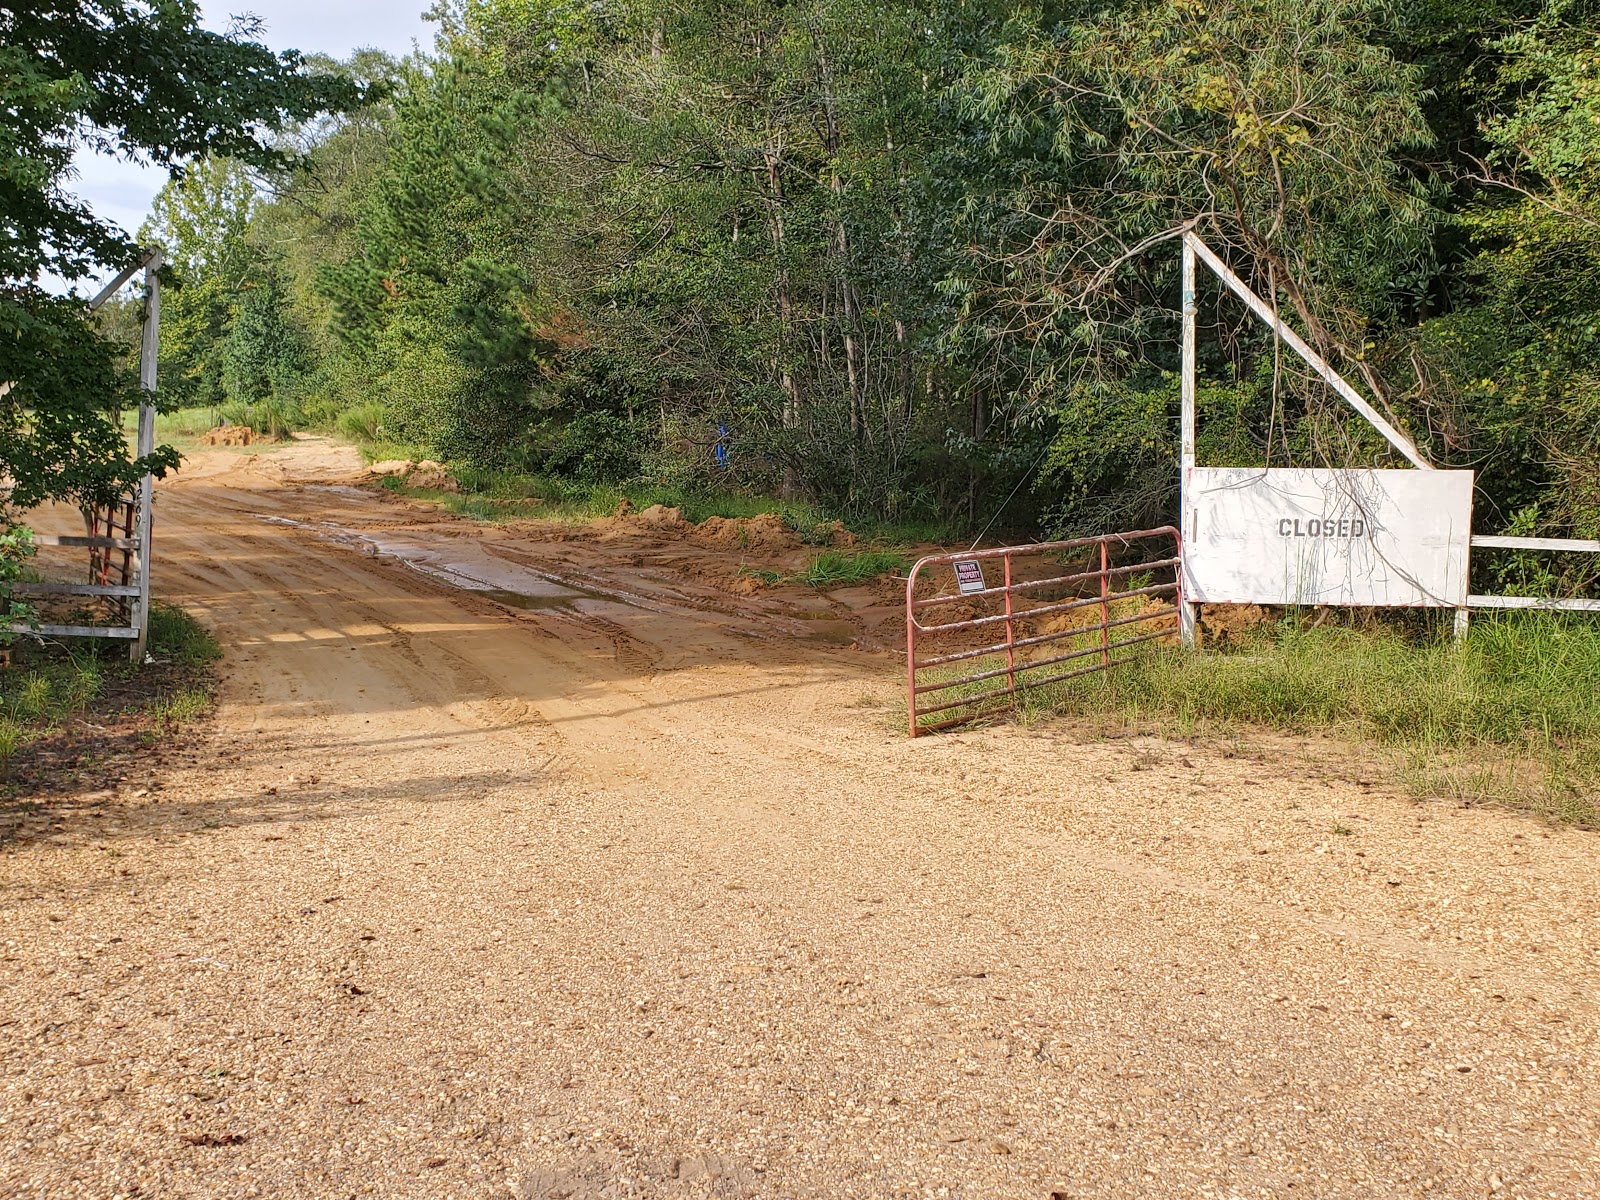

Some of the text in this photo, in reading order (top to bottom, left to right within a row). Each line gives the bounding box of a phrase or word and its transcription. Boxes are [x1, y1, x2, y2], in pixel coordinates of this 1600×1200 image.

[1279, 518, 1364, 538] CLOSED
[958, 563, 977, 572] PRIVATE
[958, 571, 981, 580] PROPERTY
